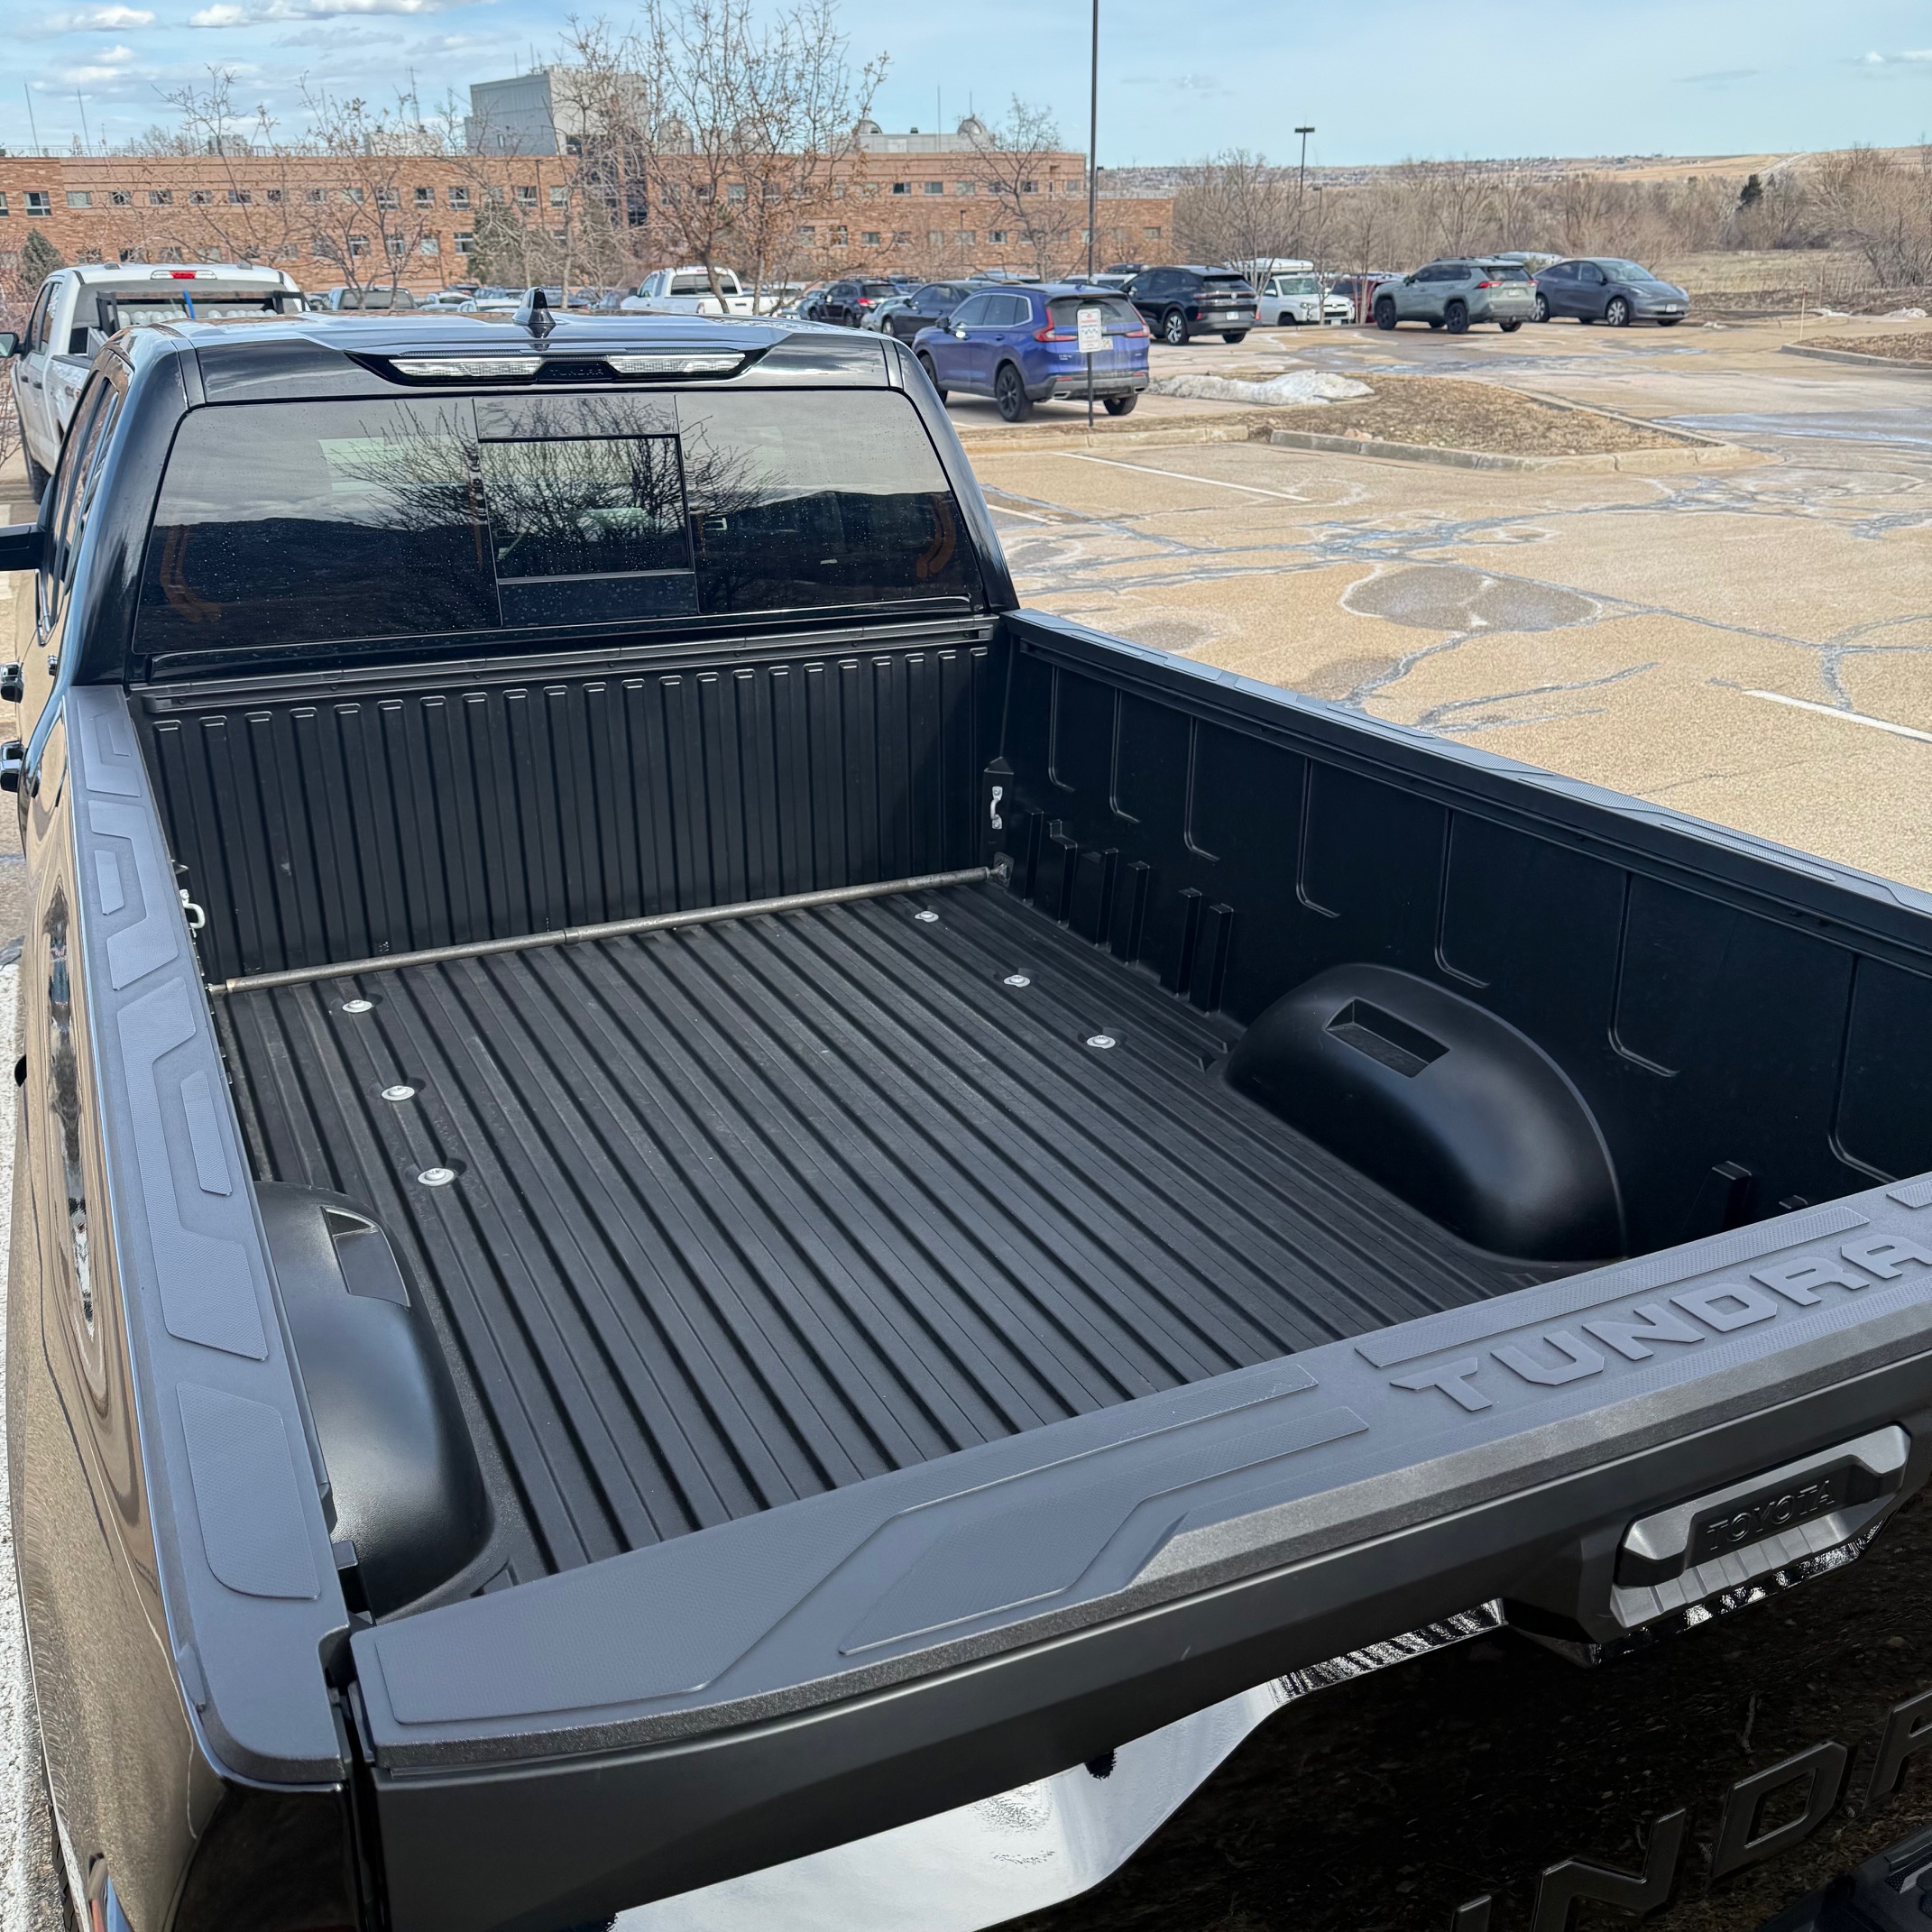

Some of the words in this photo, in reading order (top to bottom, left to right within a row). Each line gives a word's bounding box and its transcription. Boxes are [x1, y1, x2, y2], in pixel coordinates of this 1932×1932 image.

[549, 368, 604, 376] TUNDRA
[1390, 1234, 1932, 1412] TUNDRA
[1707, 1480, 1835, 1550] TOYOTA
